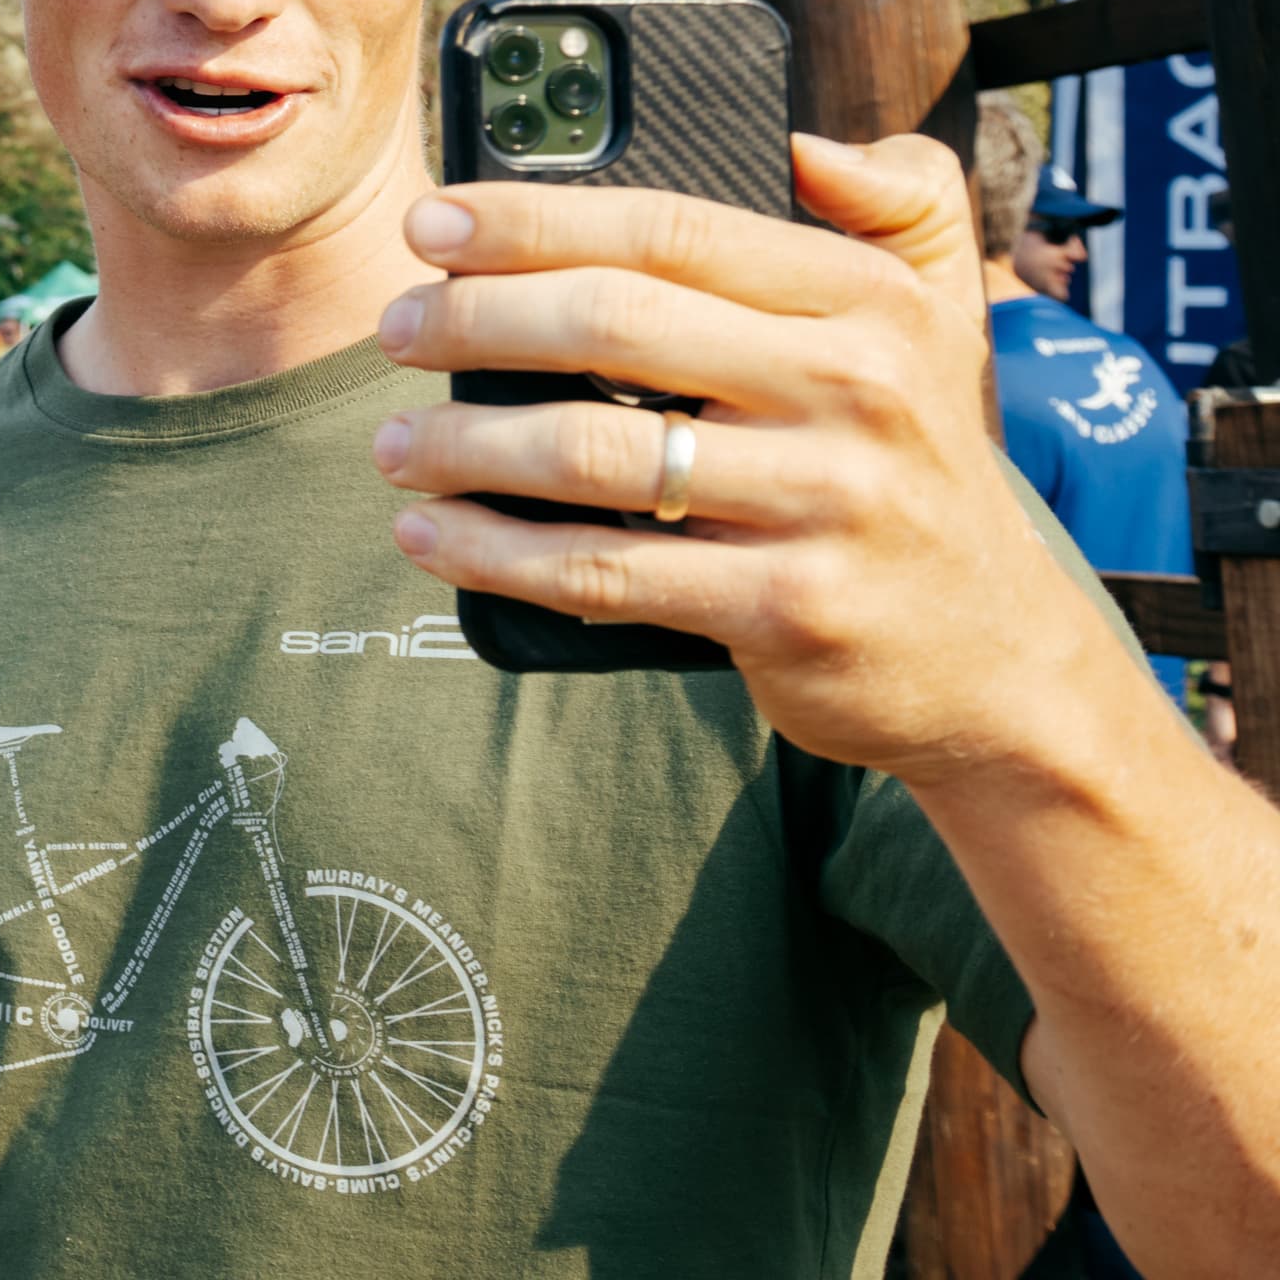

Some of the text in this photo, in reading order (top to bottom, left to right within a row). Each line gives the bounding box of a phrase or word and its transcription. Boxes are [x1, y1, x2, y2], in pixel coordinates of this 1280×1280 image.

[136, 803, 196, 852] Mackenzie
[197, 779, 223, 805] Club
[88, 842, 128, 850] SECTION
[306, 869, 408, 903] MURRAY'S
[24, 839, 55, 910] YANKEE
[47, 913, 85, 986] DOODLE
[134, 904, 164, 957] FLOATING
[196, 906, 244, 981] SECTION
[107, 988, 129, 1014] WORK
[128, 975, 138, 988] TO
[81, 1016, 134, 1032] JOLIVET
